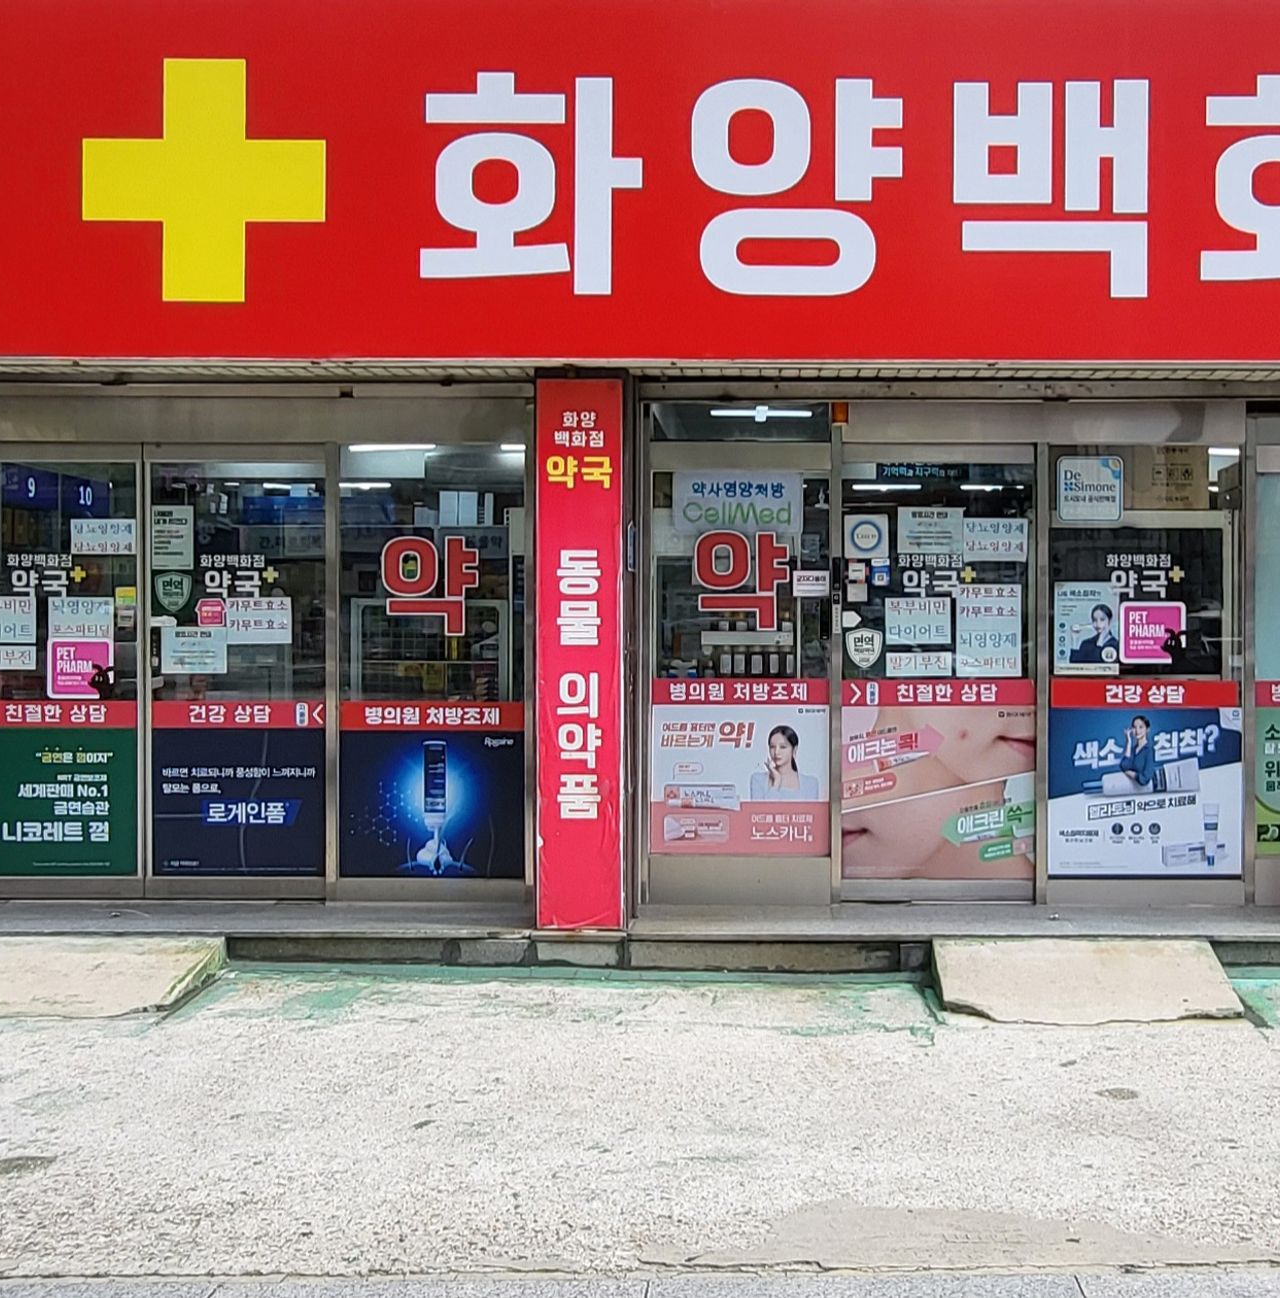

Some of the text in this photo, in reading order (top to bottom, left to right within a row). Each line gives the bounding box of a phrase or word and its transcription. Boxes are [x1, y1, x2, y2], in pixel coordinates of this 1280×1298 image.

[562, 411, 597, 429] 화양
[554, 430, 605, 448] 백화점
[546, 456, 614, 489] 약국
[1064, 470, 1081, 481] De
[28, 477, 36, 498] 9
[79, 485, 93, 506] 10
[692, 481, 785, 499] 약사영양처방
[1074, 482, 1116, 492] Simone
[682, 502, 792, 526] CellMed
[7, 553, 72, 567] 화양백화점
[199, 554, 265, 568] 화양백화점
[898, 554, 963, 568] 화양백화점
[1106, 554, 1171, 567] 화양백화점
[11, 569, 69, 598] 약국
[205, 569, 263, 598] 약국
[380, 535, 480, 636] 약
[694, 530, 790, 631] 약
[902, 569, 960, 598] 약국
[1111, 569, 1169, 598] 약국
[1129, 611, 1147, 623] PET
[889, 624, 948, 639] 다이어트
[57, 647, 76, 660] PET
[556, 549, 603, 820] 동물 의약품
[670, 683, 808, 701] 병의원 처방조제
[897, 684, 952, 702] 친절한
[961, 684, 998, 702] 상담
[1106, 685, 1185, 703] 건강 상담
[5, 704, 62, 723] 친절한
[70, 704, 107, 723] 상담
[189, 705, 271, 723] 건강 상담
[365, 707, 500, 727] 병의원 처방조제
[1073, 724, 1219, 770] 색소 침착?
[77, 785, 108, 797] No.1
[54, 801, 110, 815] 금연습관
[207, 802, 286, 824] 로게인폼
[2, 821, 110, 842] 니코레트 껌
[751, 826, 807, 842] 노스카나
